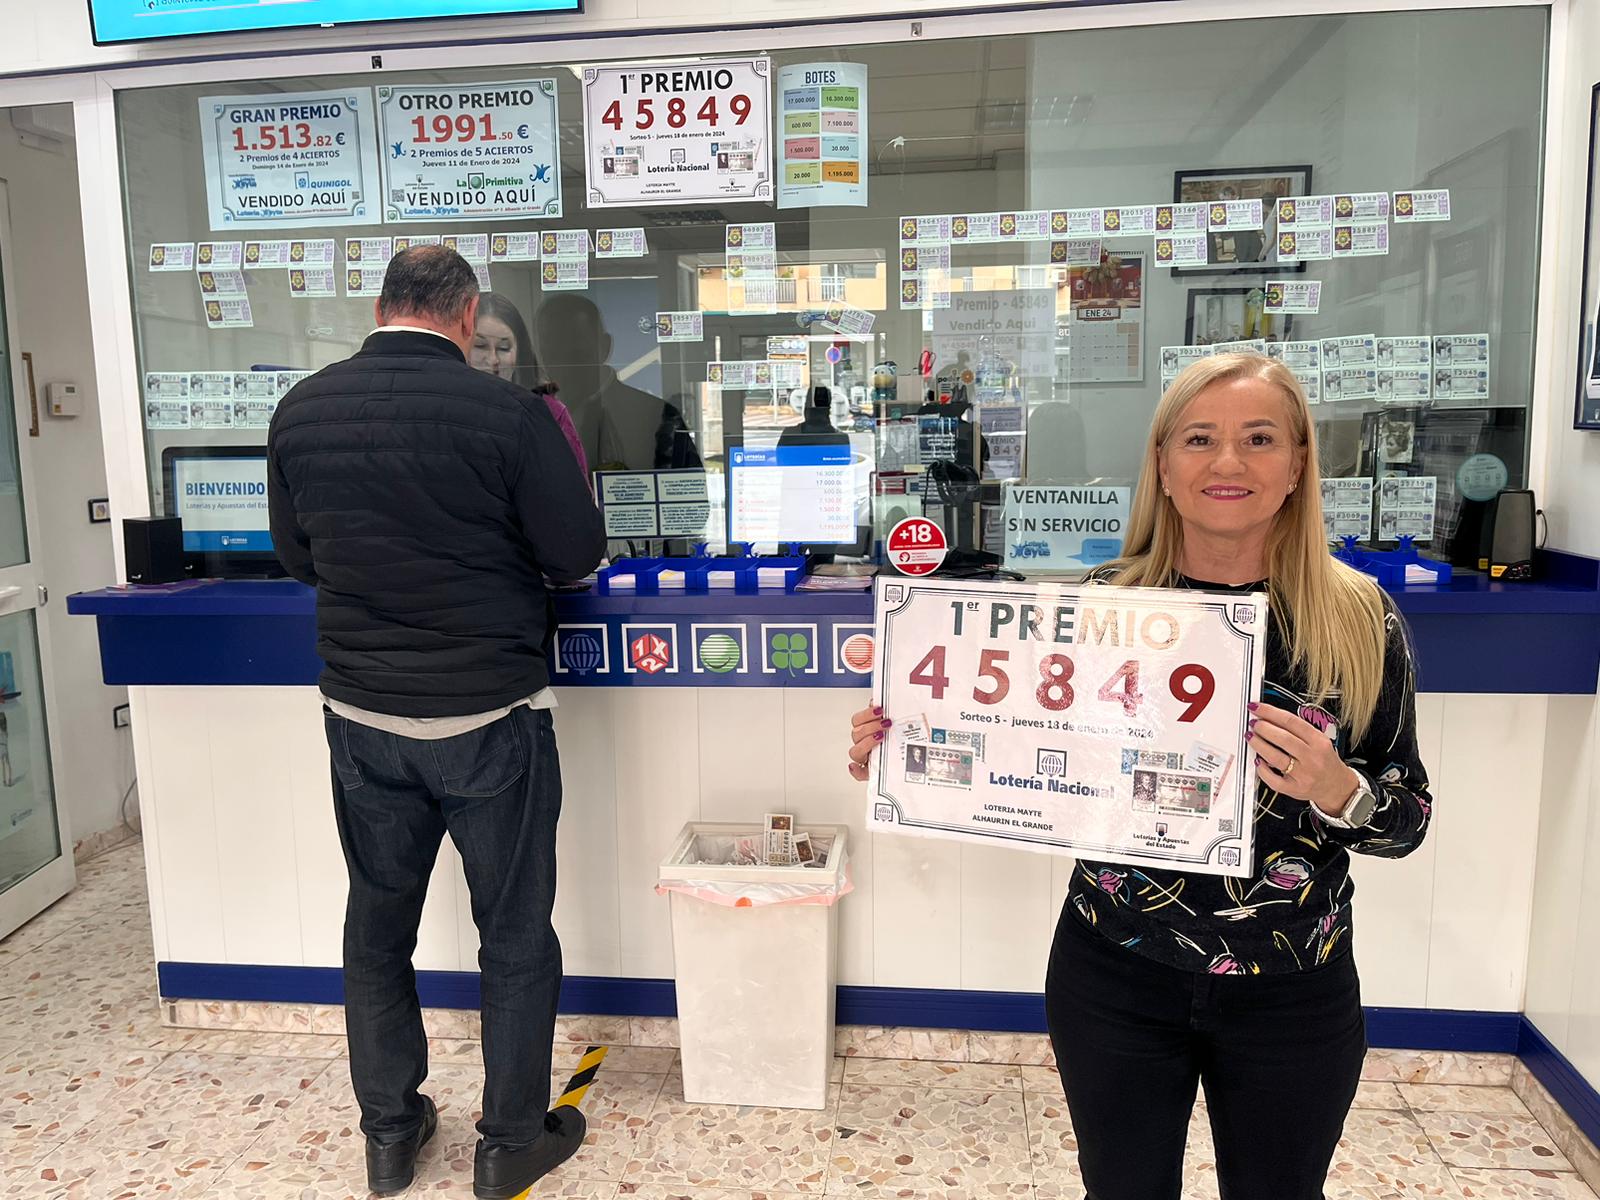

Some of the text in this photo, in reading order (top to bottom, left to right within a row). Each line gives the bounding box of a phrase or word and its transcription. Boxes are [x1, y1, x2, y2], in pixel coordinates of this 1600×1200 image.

[641, 69, 733, 93] PREMIO
[806, 70, 836, 83] BOTES
[400, 90, 533, 110] OTRO PREMIO
[230, 104, 341, 123] GRAN PREMIO
[602, 94, 752, 130] 45849
[336, 132, 345, 145] €
[517, 124, 529, 139] €
[656, 133, 673, 141] jueves
[247, 154, 278, 162] Premios
[280, 152, 290, 160] de
[292, 152, 299, 160] 4
[300, 150, 340, 160] ACIERTOS
[410, 145, 533, 158] 2 Premios de 5 ACIERTOS
[422, 160, 446, 168] Jueves
[648, 163, 709, 173] Lotería Nacional
[310, 179, 352, 188] QUINIGOL
[456, 176, 523, 187] La Primitiva
[238, 189, 345, 208] VENDIDO AQUÍ
[406, 185, 536, 206] VENDIDO AQUÍ
[956, 297, 999, 311] Premio
[950, 319, 1001, 331] Vendido
[186, 482, 265, 495] BIENVENIDO
[1013, 490, 1119, 504] VENTANILLA
[1042, 518, 1120, 532] SERVICIO
[899, 524, 932, 543] +18
[989, 602, 1180, 651] PREMIO
[908, 645, 1216, 723] 45849
[960, 712, 991, 723] Sorteo
[994, 714, 1000, 723] 5
[1011, 716, 1044, 729] jueves
[1062, 720, 1074, 731] de
[989, 772, 1115, 799] Lotería Nacional
[984, 804, 1042, 817] LOTERIA MAYTE
[972, 815, 1010, 826] ALHAURIN
[1022, 820, 1053, 831] GRANDE
